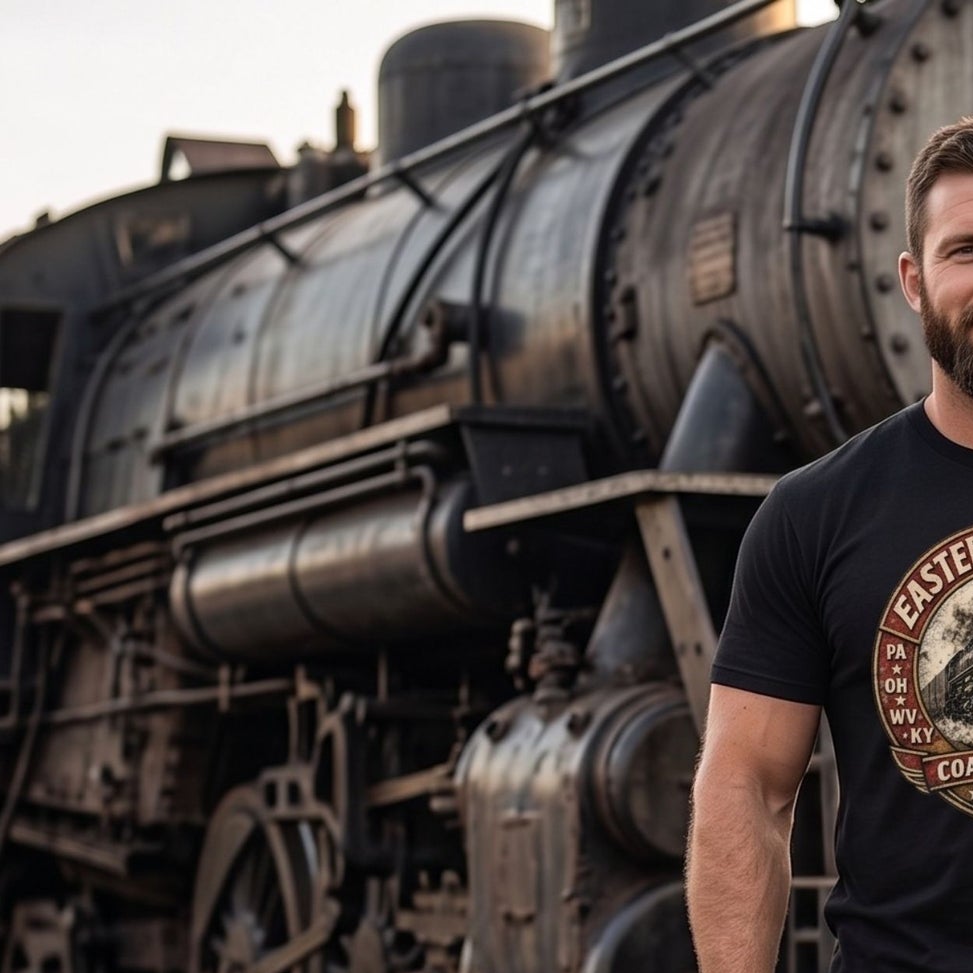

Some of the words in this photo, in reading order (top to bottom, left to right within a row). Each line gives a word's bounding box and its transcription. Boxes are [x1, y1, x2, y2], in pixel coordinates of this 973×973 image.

[886, 643, 907, 660] PA
[884, 678, 907, 694] OH
[890, 708, 917, 725] WV
[911, 727, 933, 744] KY
